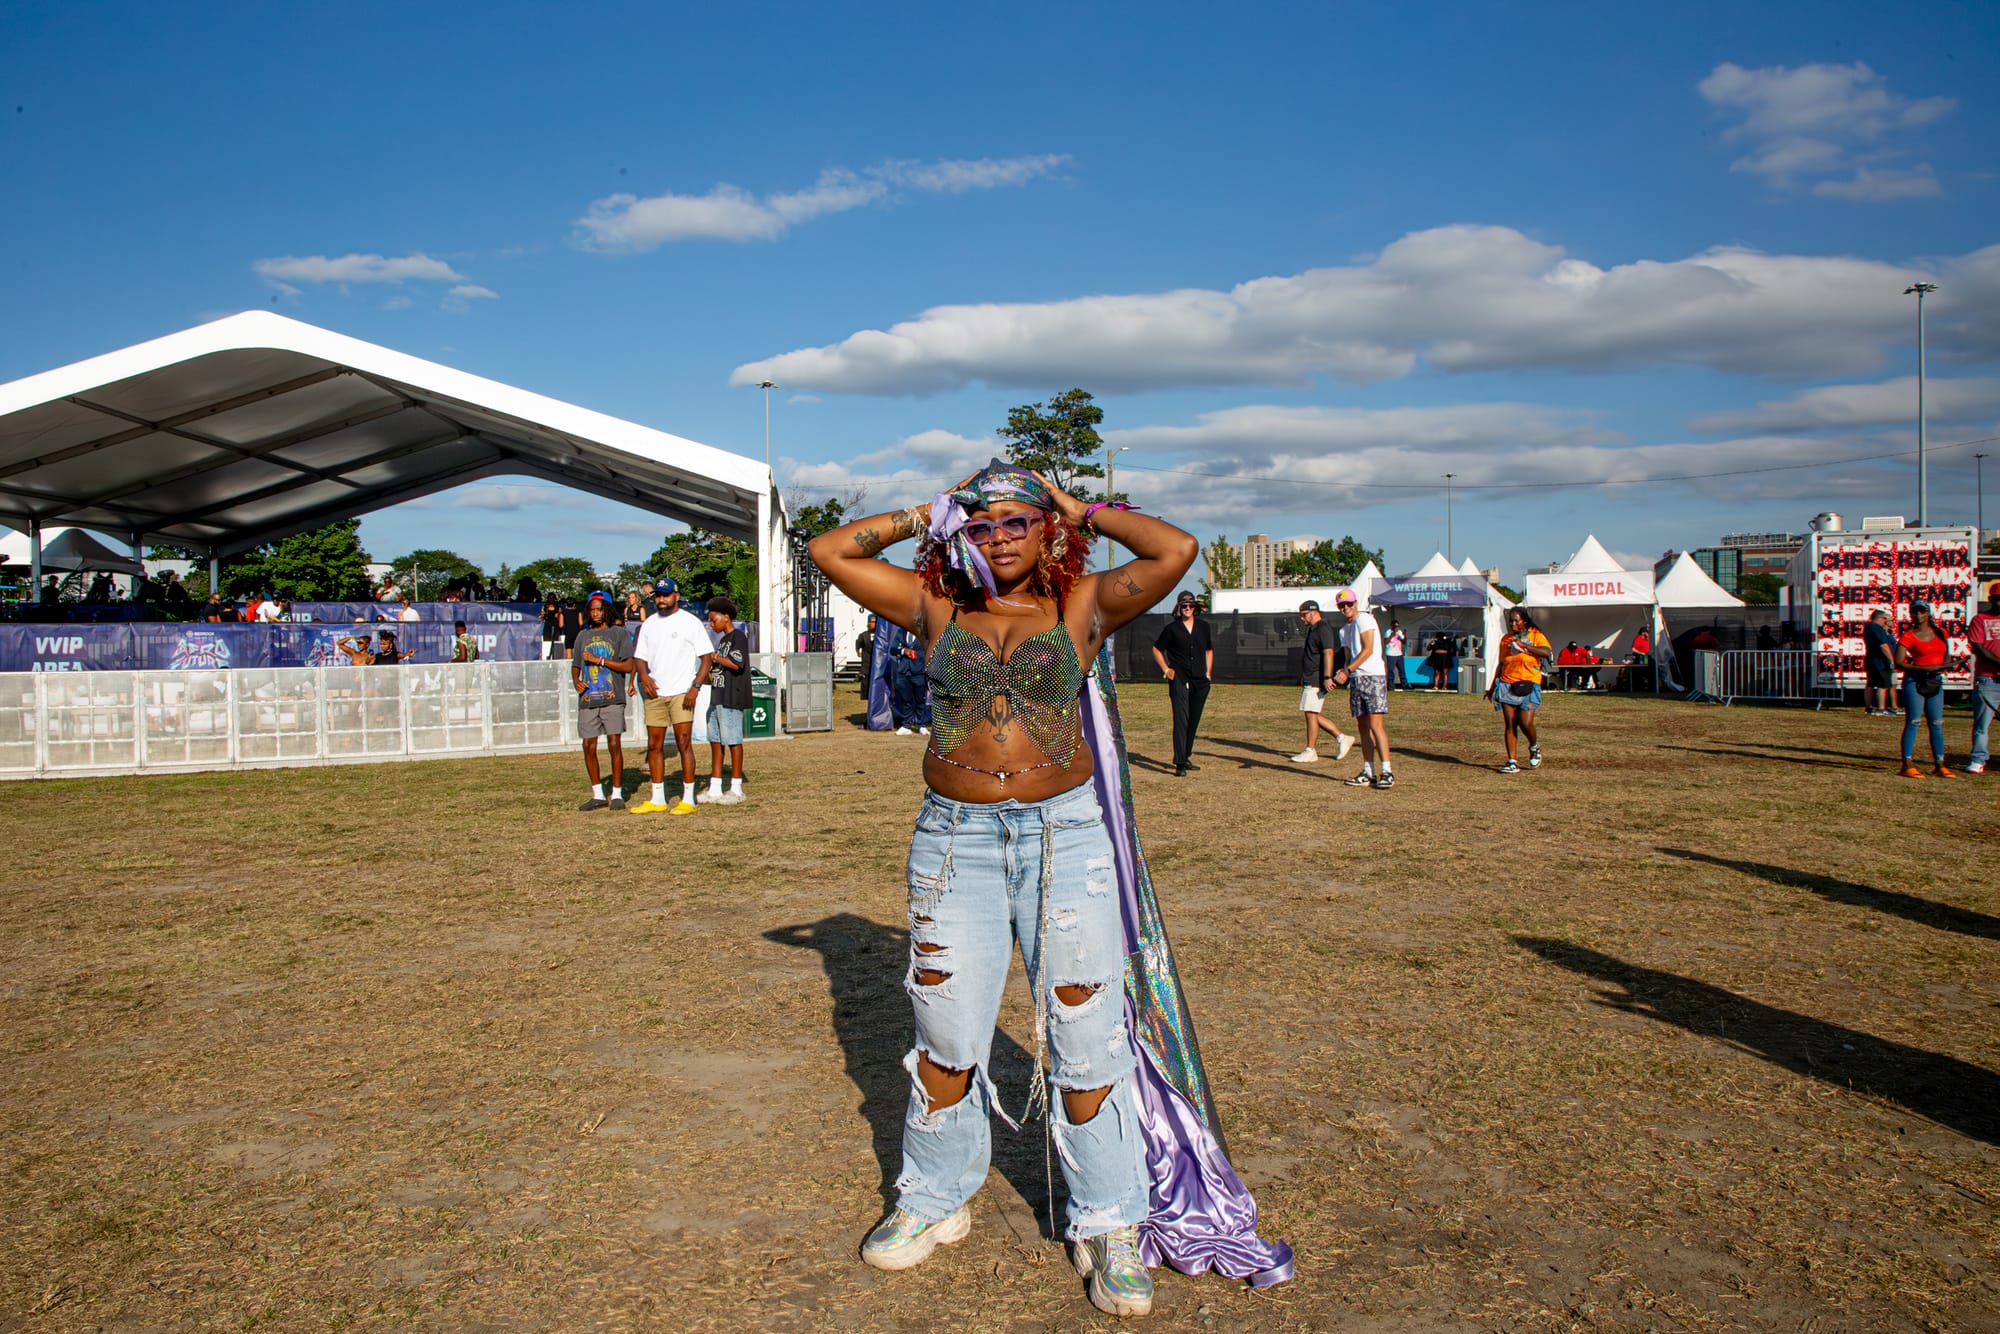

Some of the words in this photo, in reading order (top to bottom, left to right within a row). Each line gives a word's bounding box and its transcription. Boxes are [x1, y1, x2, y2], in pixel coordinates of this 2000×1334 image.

[1899, 550, 1970, 567] REMIX
[1897, 567, 1971, 585] REMIX
[1394, 583, 1426, 592] WATER
[1430, 582, 1463, 591] REFILL
[1554, 582, 1625, 596] MEDICAL
[1900, 585, 1971, 602] REMIX
[1408, 592, 1448, 601] STATION
[36, 636, 84, 654] VVIP
